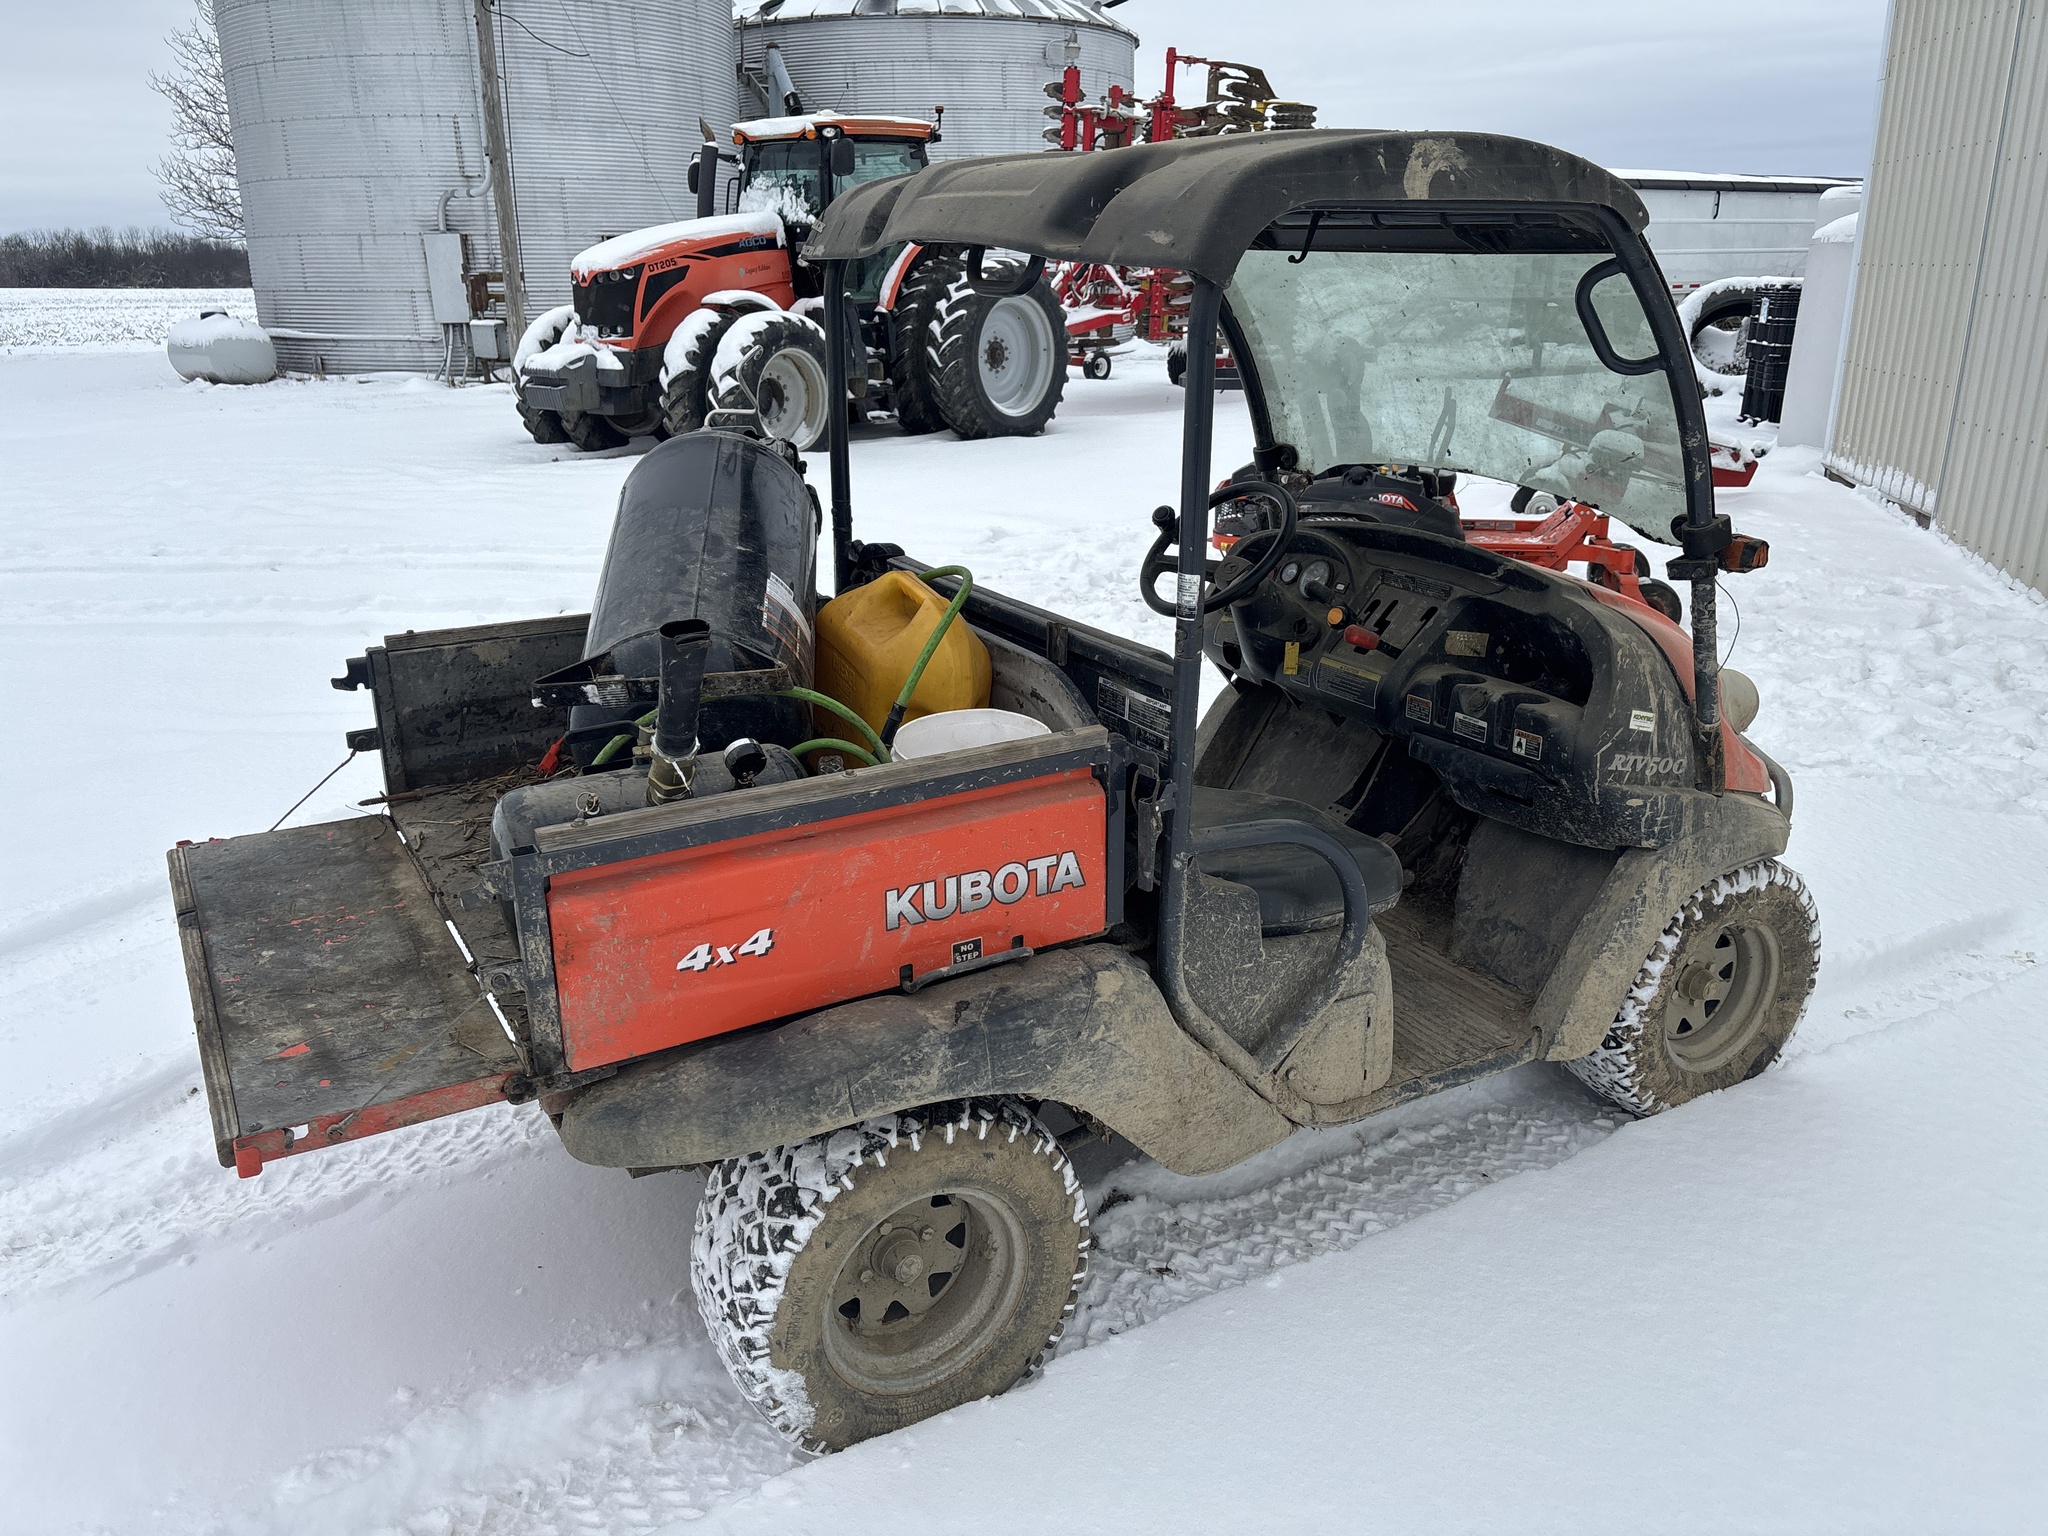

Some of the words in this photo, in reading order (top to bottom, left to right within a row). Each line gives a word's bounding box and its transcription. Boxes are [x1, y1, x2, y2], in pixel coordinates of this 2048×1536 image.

[739, 235, 767, 248] AGCO
[648, 258, 676, 272] DT205
[1608, 754, 1687, 776] RTV500
[885, 850, 1086, 931] KUBOTA
[676, 928, 774, 972] 4x4
[960, 943, 974, 952] NO
[956, 951, 979, 963] STEP
